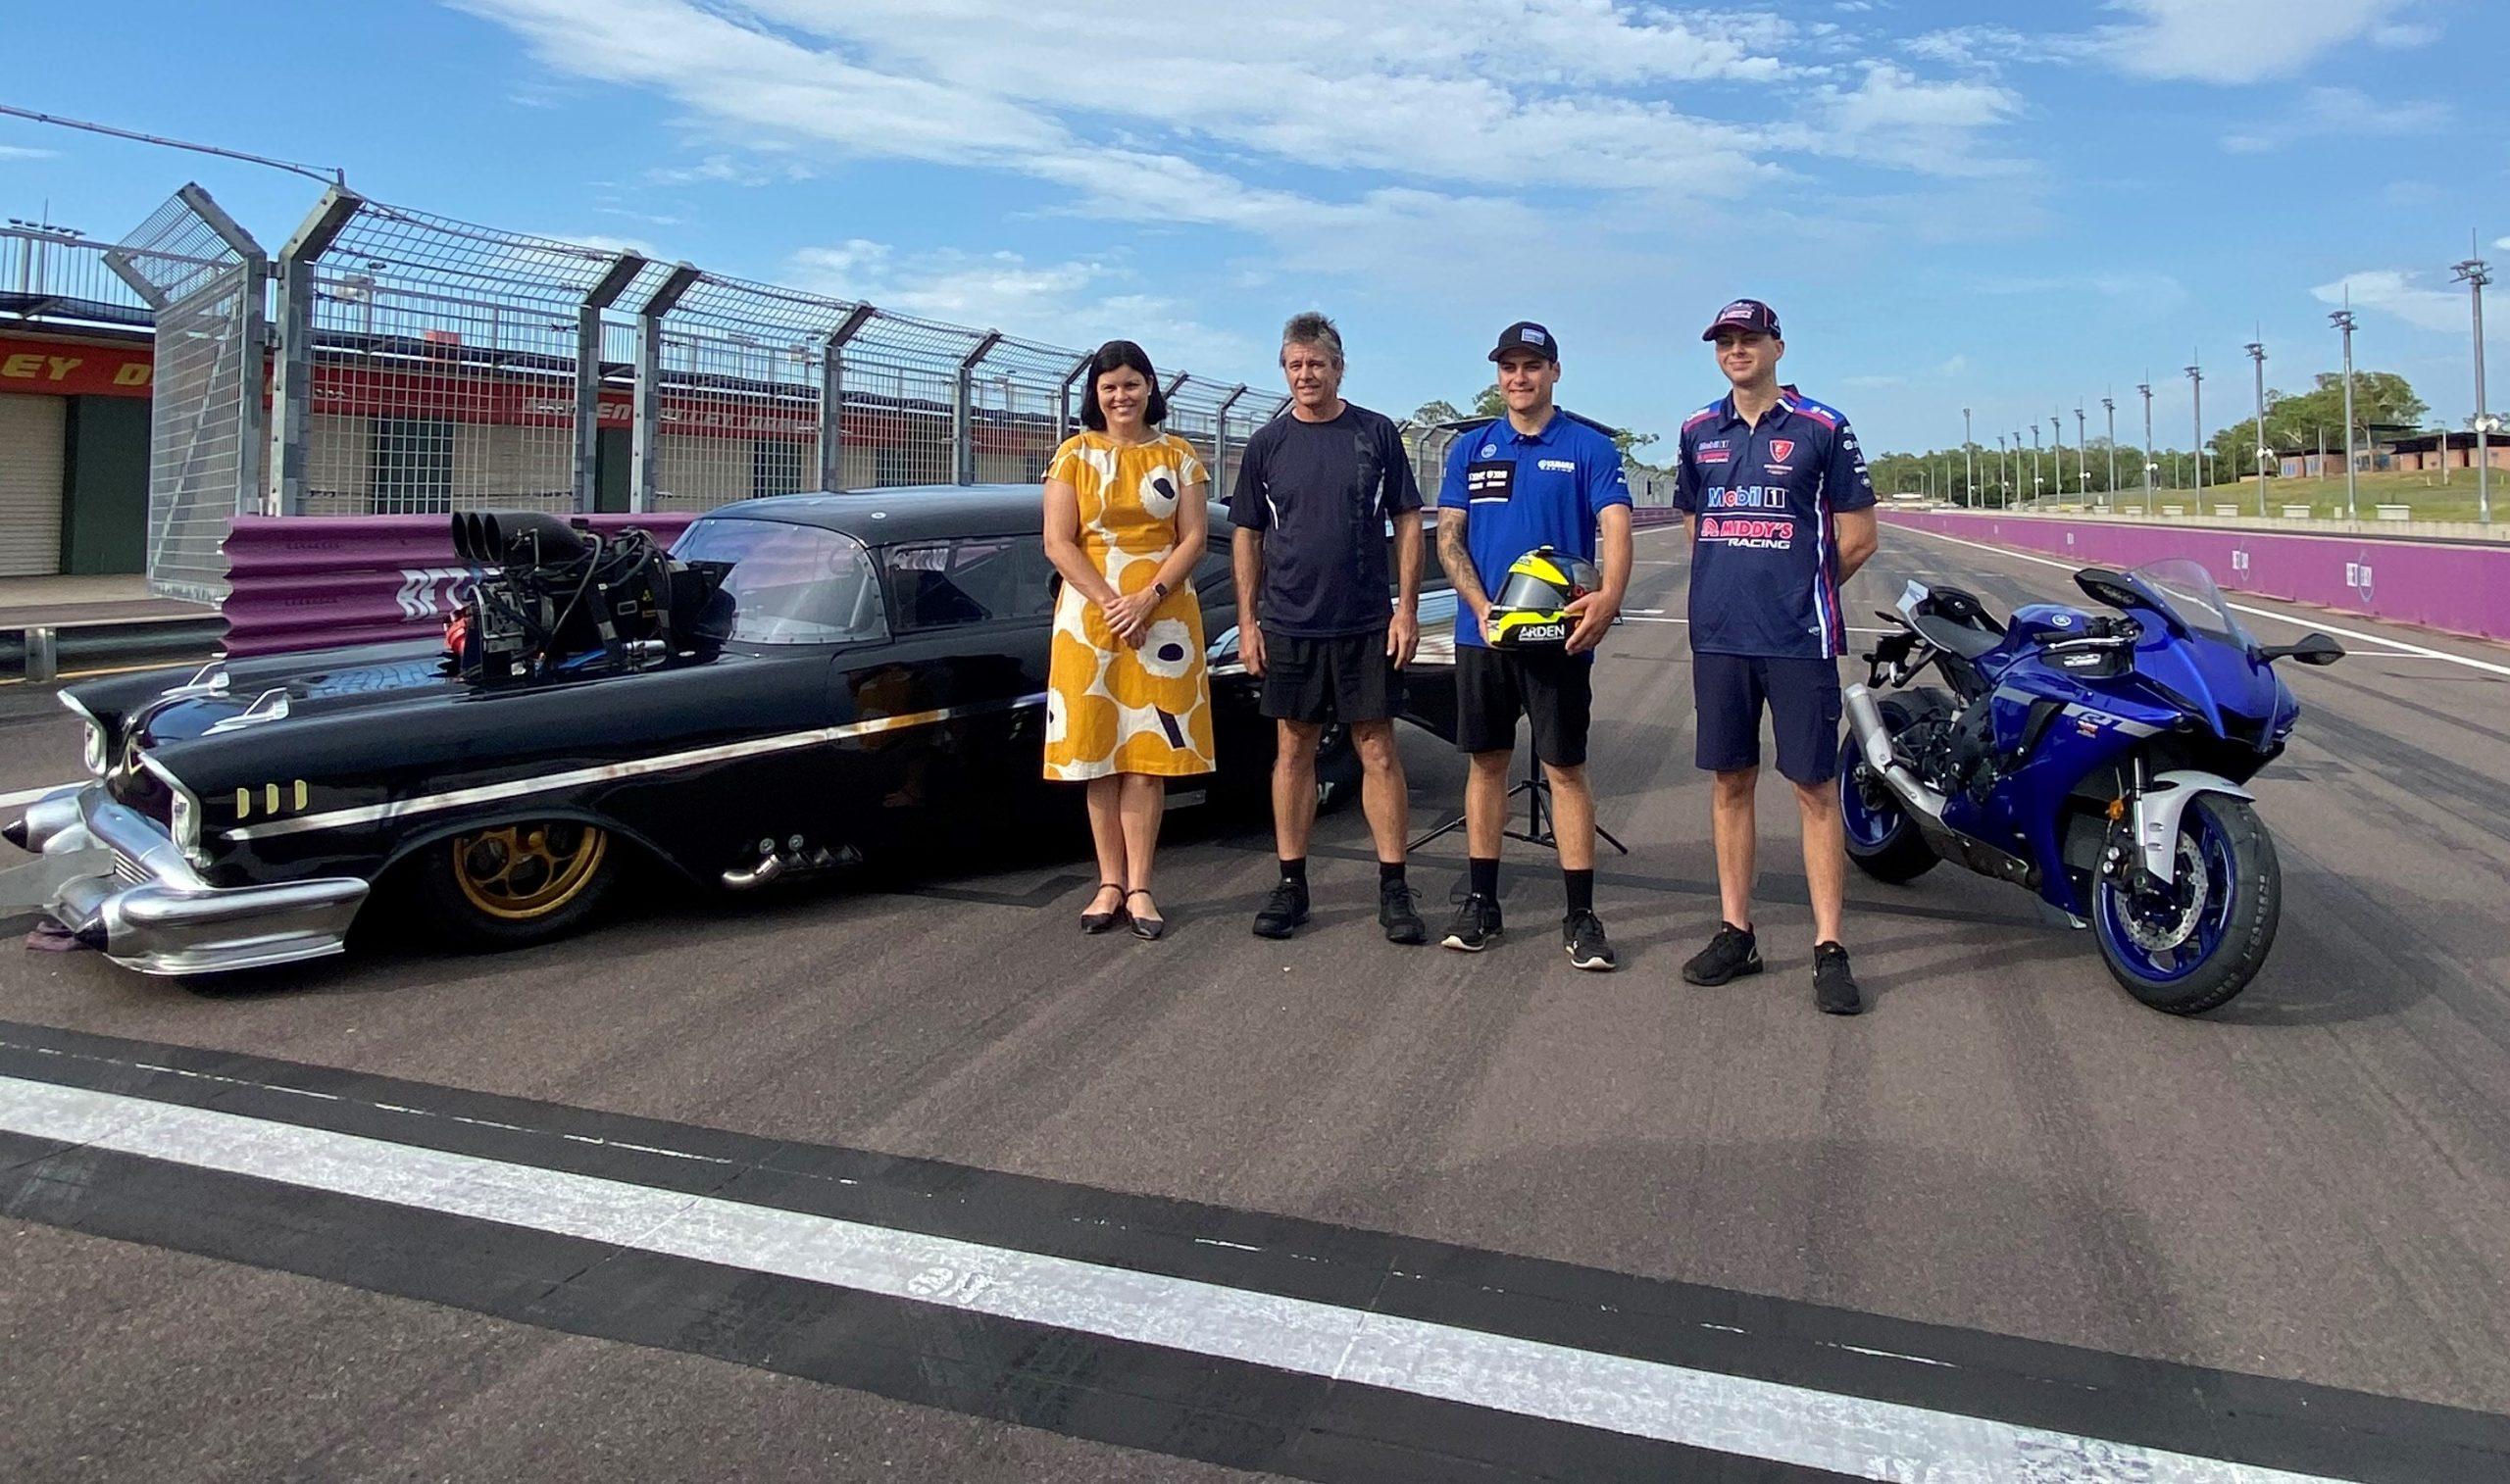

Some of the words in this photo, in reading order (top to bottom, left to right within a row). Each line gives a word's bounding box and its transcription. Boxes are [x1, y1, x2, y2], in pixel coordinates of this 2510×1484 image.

[1708, 485, 1762, 508] Mobil
[1721, 519, 1793, 539] MIDDY'S
[1728, 538, 1791, 550] RACING
[1519, 624, 1566, 639] ARDEN
